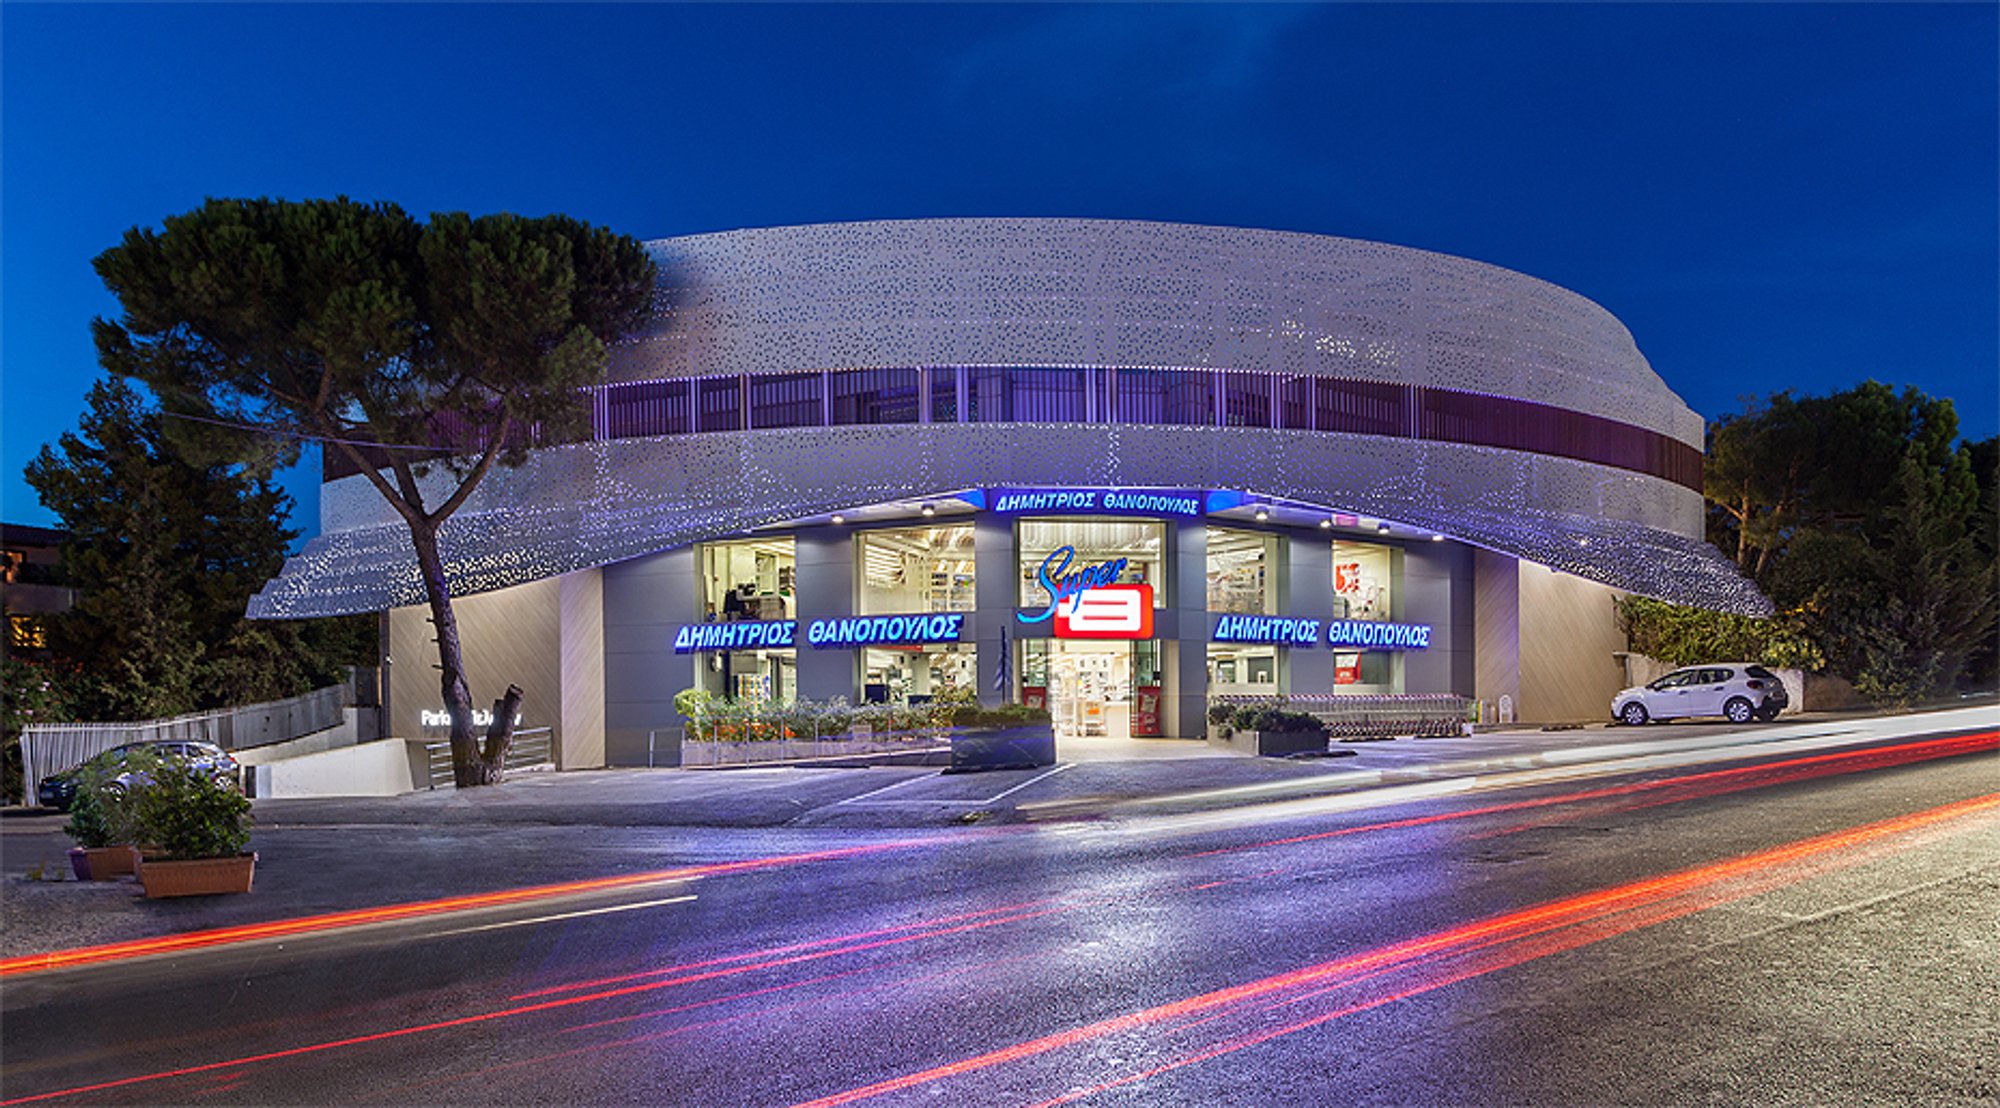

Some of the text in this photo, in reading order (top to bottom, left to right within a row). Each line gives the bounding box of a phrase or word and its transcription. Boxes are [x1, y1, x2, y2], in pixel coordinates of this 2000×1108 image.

[996, 493, 1199, 515] ΔΗΜΗΤΡΙΟΣ ΘΑΝΟΠΟΥΛΟΣ
[1016, 545, 1128, 623] Super
[674, 615, 963, 648] ΔΗΜΗΤΡΙΟΣ ΘΑΝΟΠΟΥΛΟΣ
[1215, 616, 1431, 647] ΔΗΜΗΤΡΙΟΣ ΘΑΝΟΠΟΥΛΟΣ
